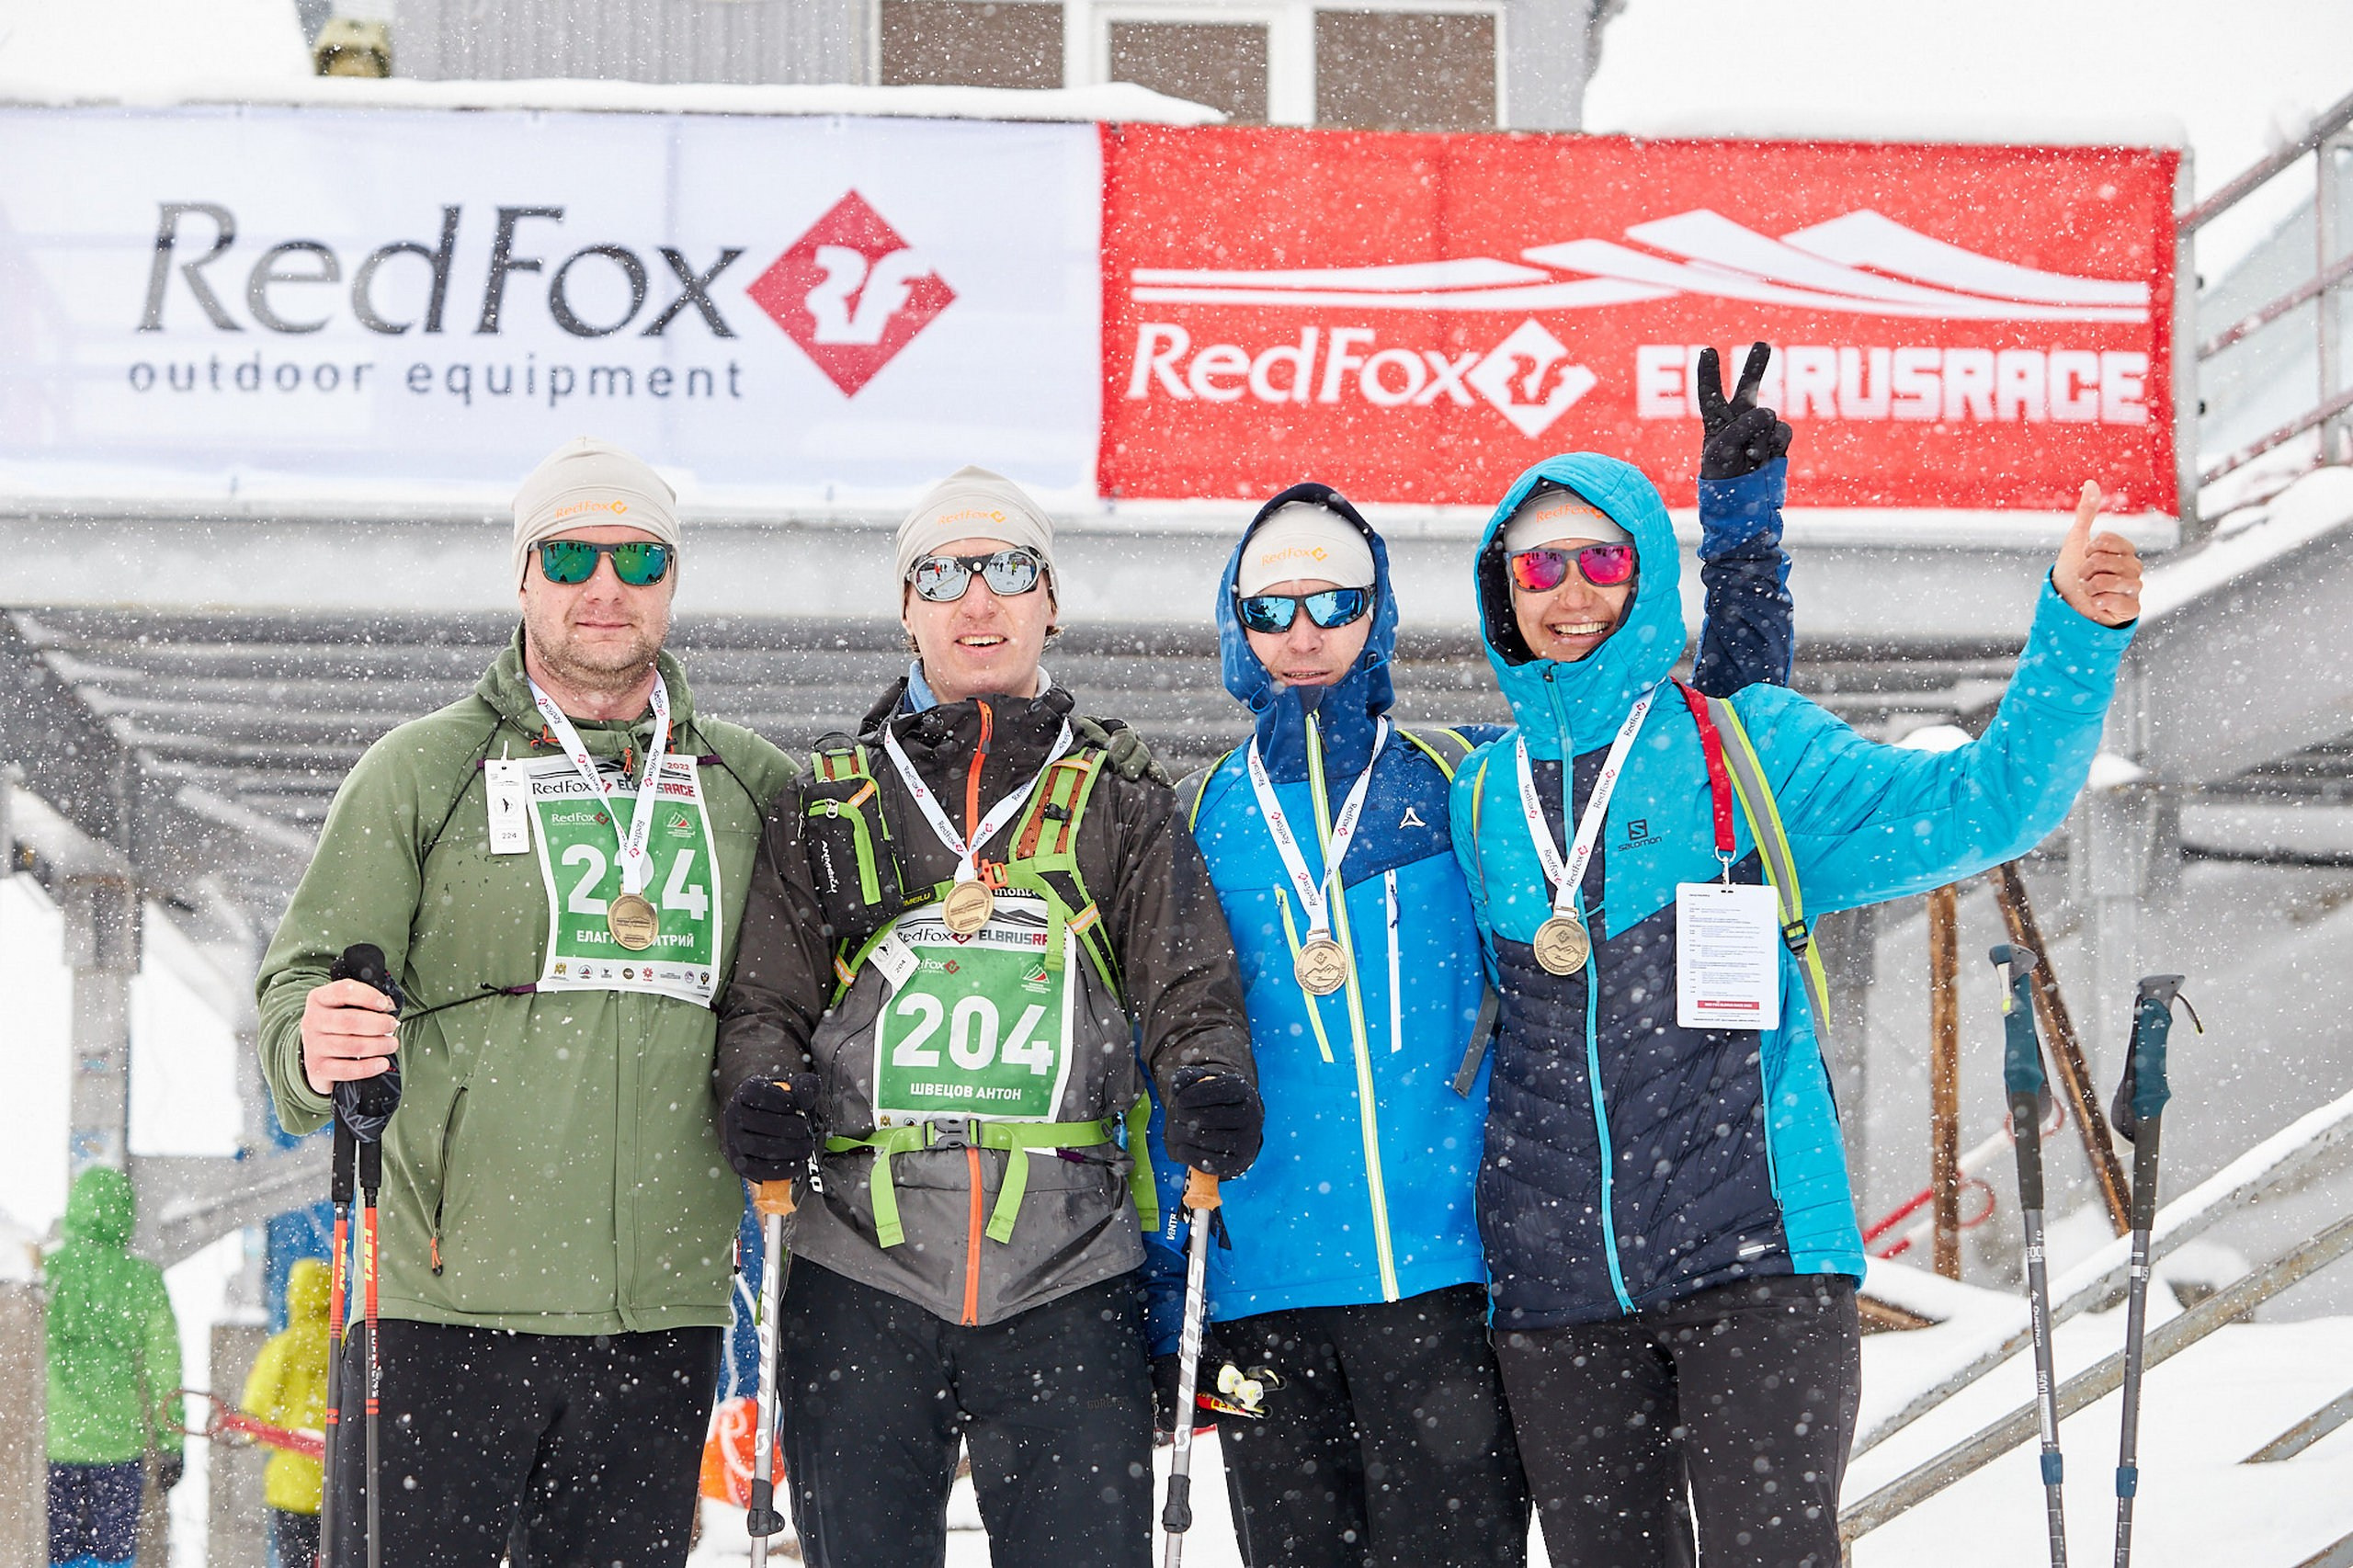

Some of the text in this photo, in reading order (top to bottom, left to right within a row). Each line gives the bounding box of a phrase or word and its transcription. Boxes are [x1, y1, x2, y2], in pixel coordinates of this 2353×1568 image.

[134, 199, 748, 339] RedFox
[1123, 322, 1482, 406] RedFox
[128, 349, 743, 408] outdoor equipment
[554, 499, 610, 519] RedFox
[1536, 503, 1589, 523] RedFox
[1261, 546, 1312, 567] RedFox
[666, 761, 691, 771] 2022
[531, 778, 697, 798] RedFox ELBSRACE
[551, 811, 597, 823] RedFox
[501, 832, 517, 840] 224
[994, 887, 1033, 897] mont
[576, 929, 695, 948] ЕЛАГ ИТРИЙ
[978, 928, 1066, 950] ELBRUSRA
[892, 992, 1055, 1076] 204
[910, 1082, 1022, 1101] ШВЕЦОВ АНТОН
[756, 1262, 777, 1419] SCOTT
[1177, 1251, 1205, 1415] SCOTT
